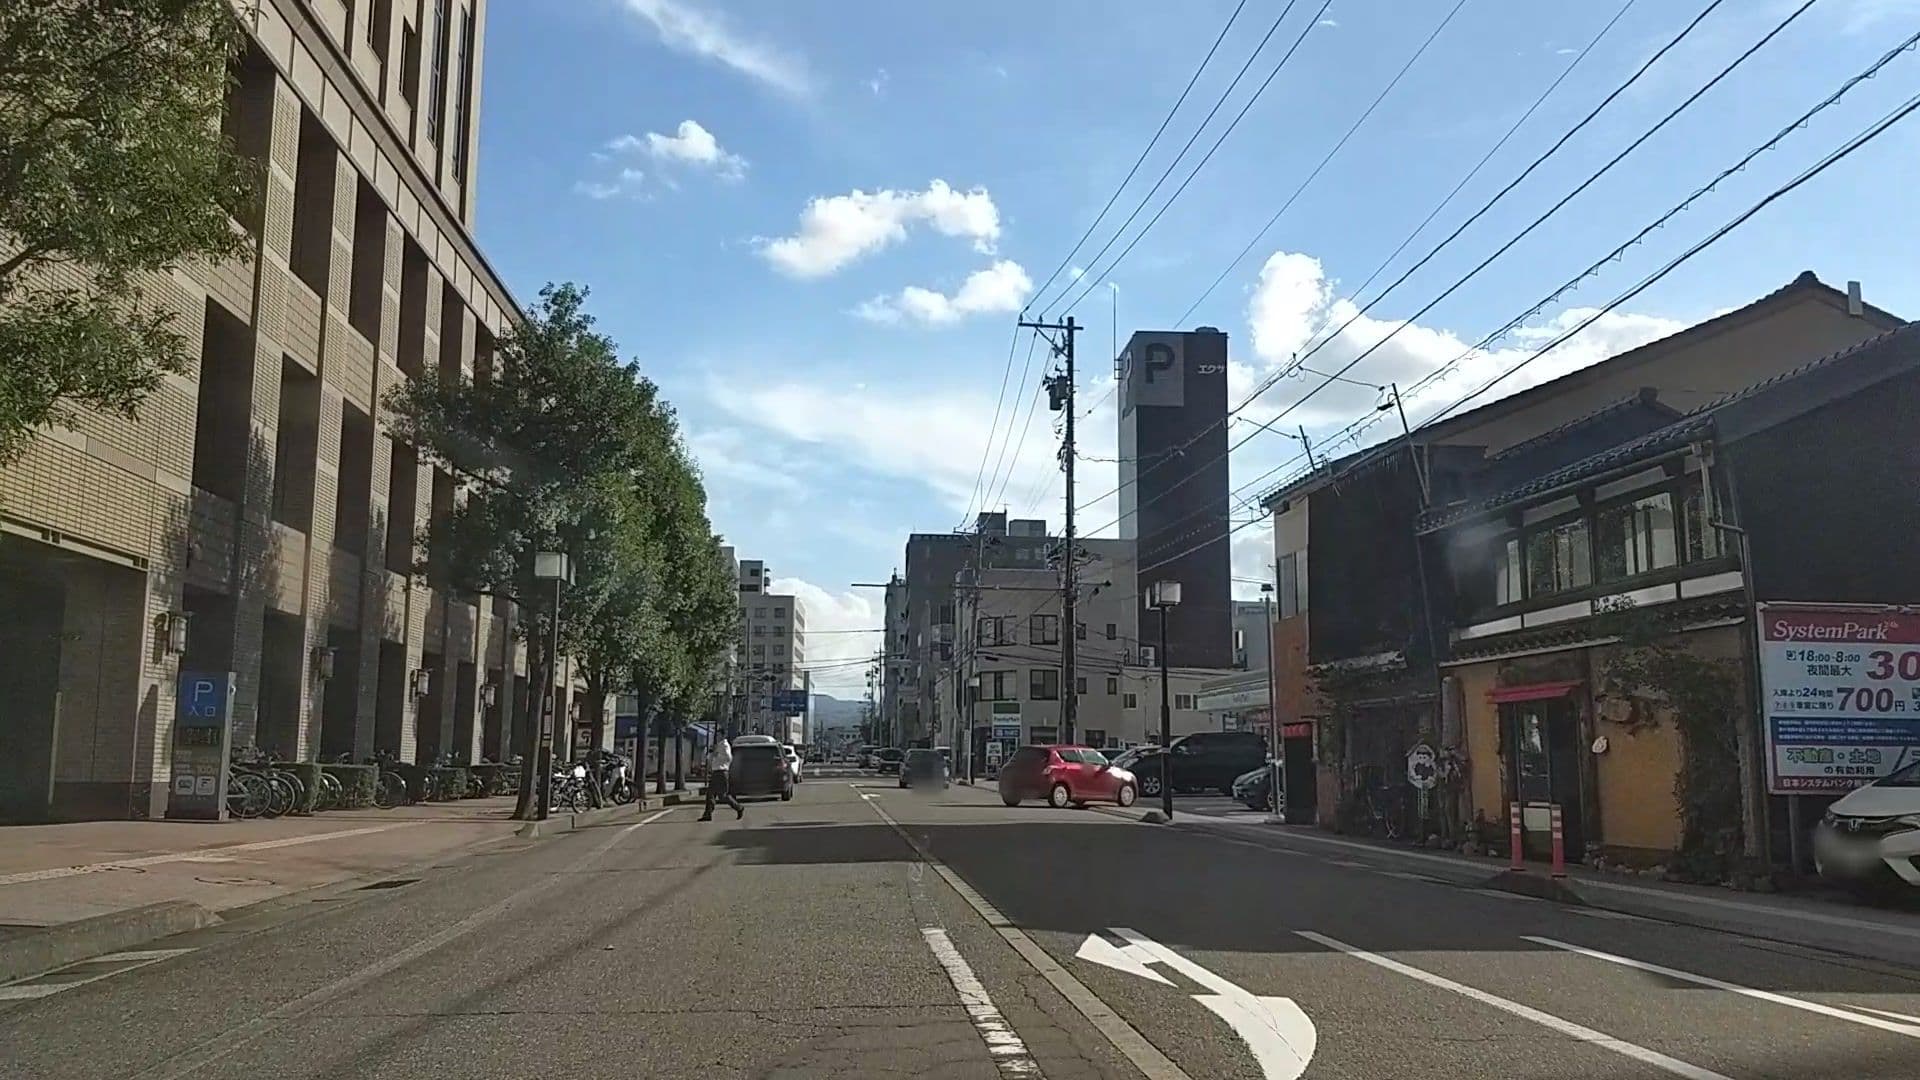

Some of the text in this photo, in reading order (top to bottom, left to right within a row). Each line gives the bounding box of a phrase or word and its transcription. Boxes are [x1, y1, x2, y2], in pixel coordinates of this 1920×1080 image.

[1145, 343, 1175, 384] P
[1773, 620, 1888, 641] SystemPark
[194, 681, 213, 702] P
[189, 706, 216, 717] 入口
